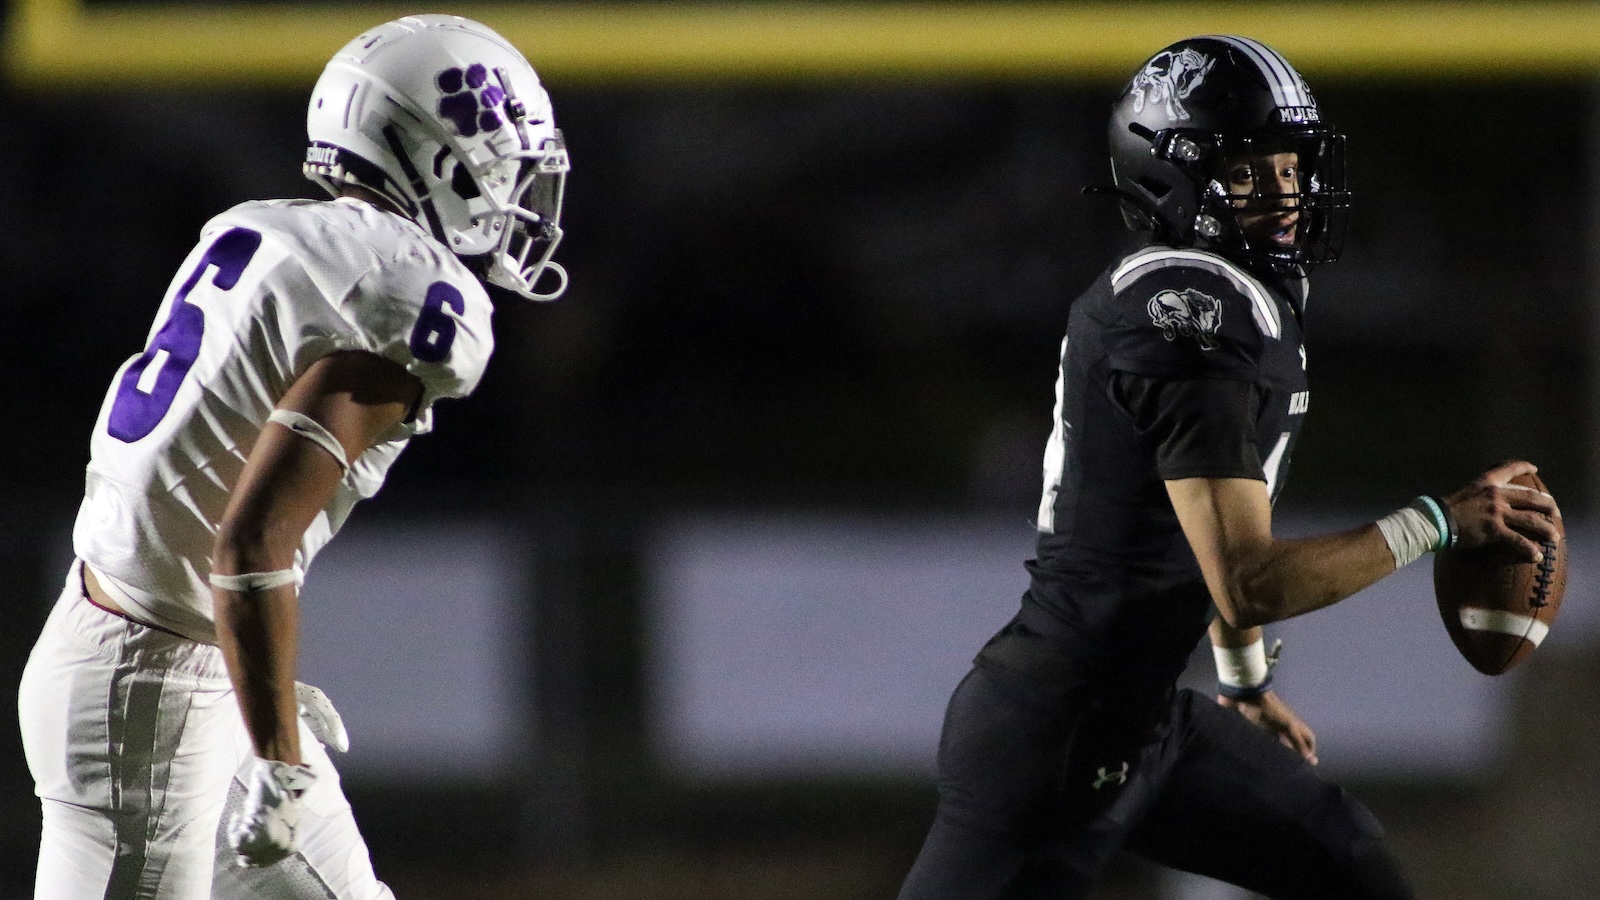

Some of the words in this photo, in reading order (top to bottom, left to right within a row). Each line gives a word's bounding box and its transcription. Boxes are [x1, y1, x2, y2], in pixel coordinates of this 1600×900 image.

[1279, 107, 1319, 123] MULES
[107, 227, 262, 443] 6
[410, 280, 465, 364] 6
